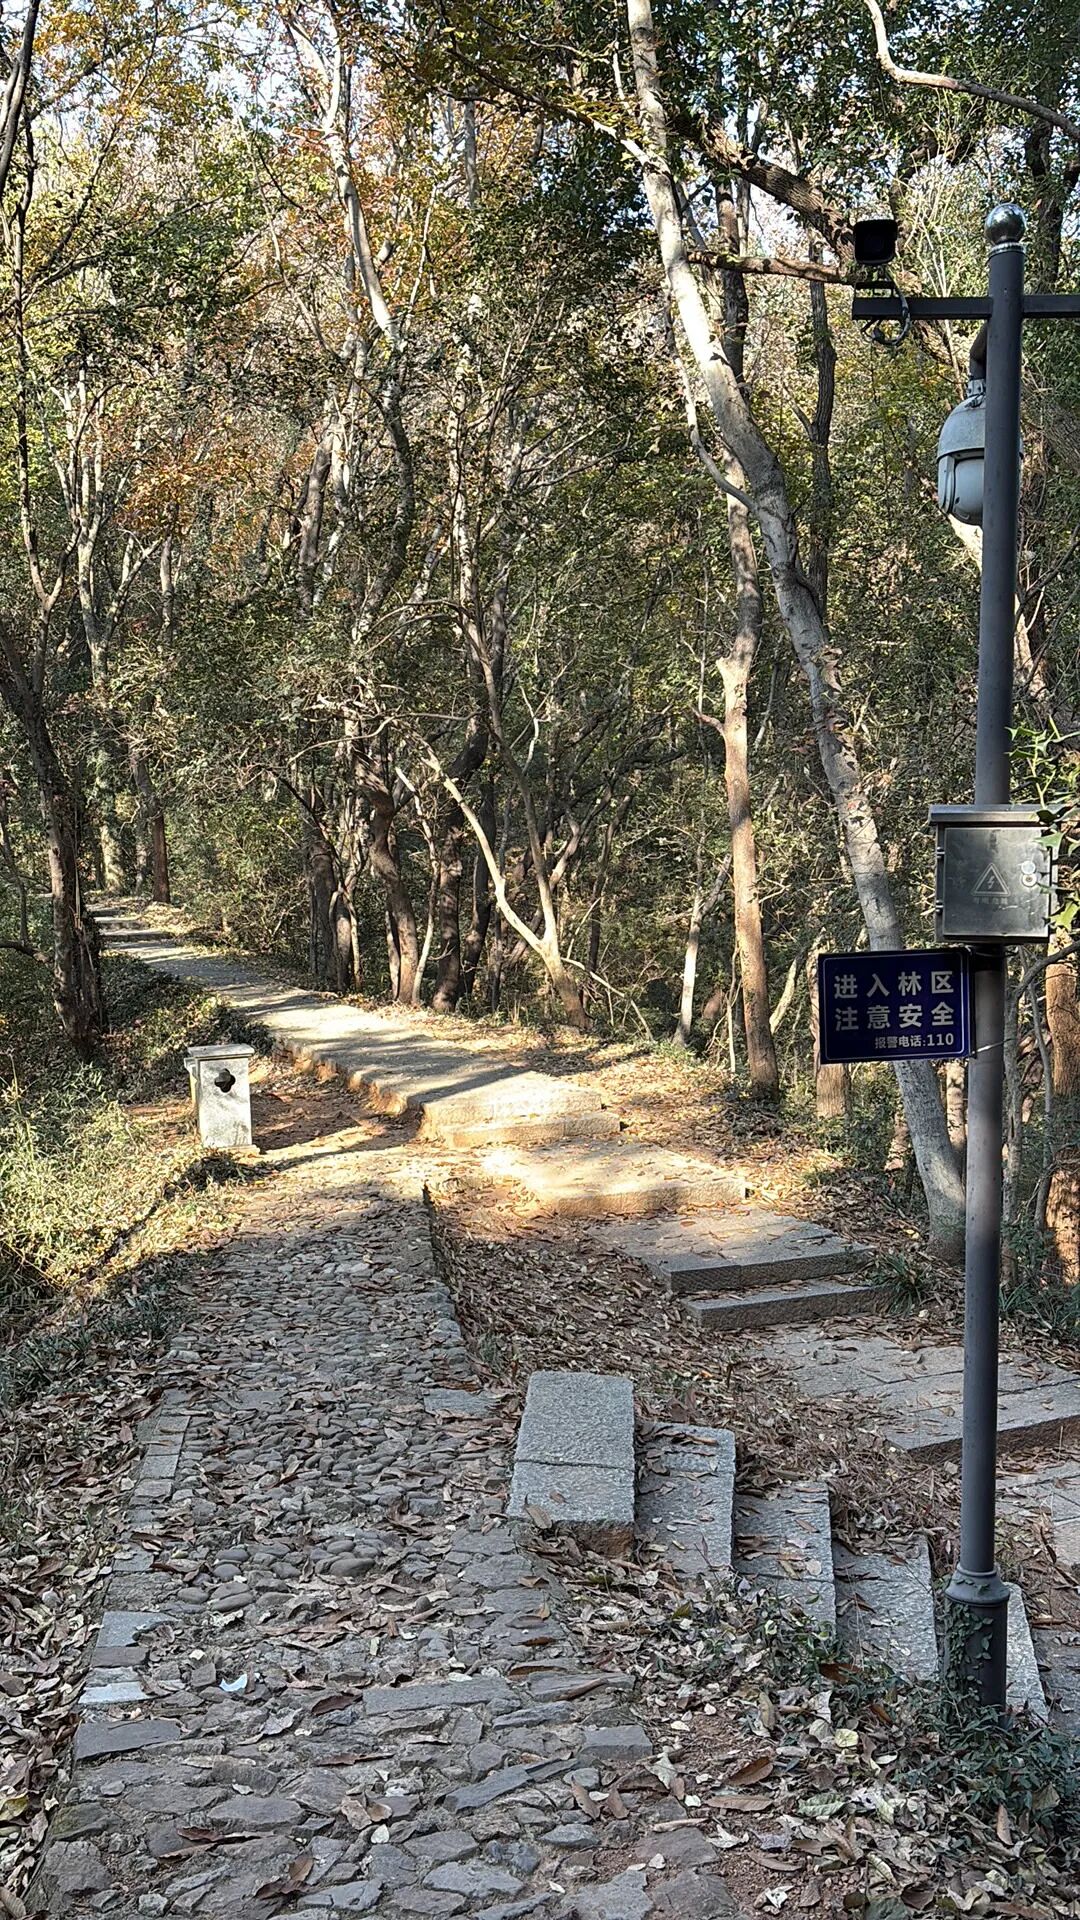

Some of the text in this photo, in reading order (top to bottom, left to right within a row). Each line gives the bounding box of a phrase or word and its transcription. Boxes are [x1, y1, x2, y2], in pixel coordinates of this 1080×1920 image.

[834, 971, 954, 999] 进入林区
[835, 1001, 954, 1031] 注意安全
